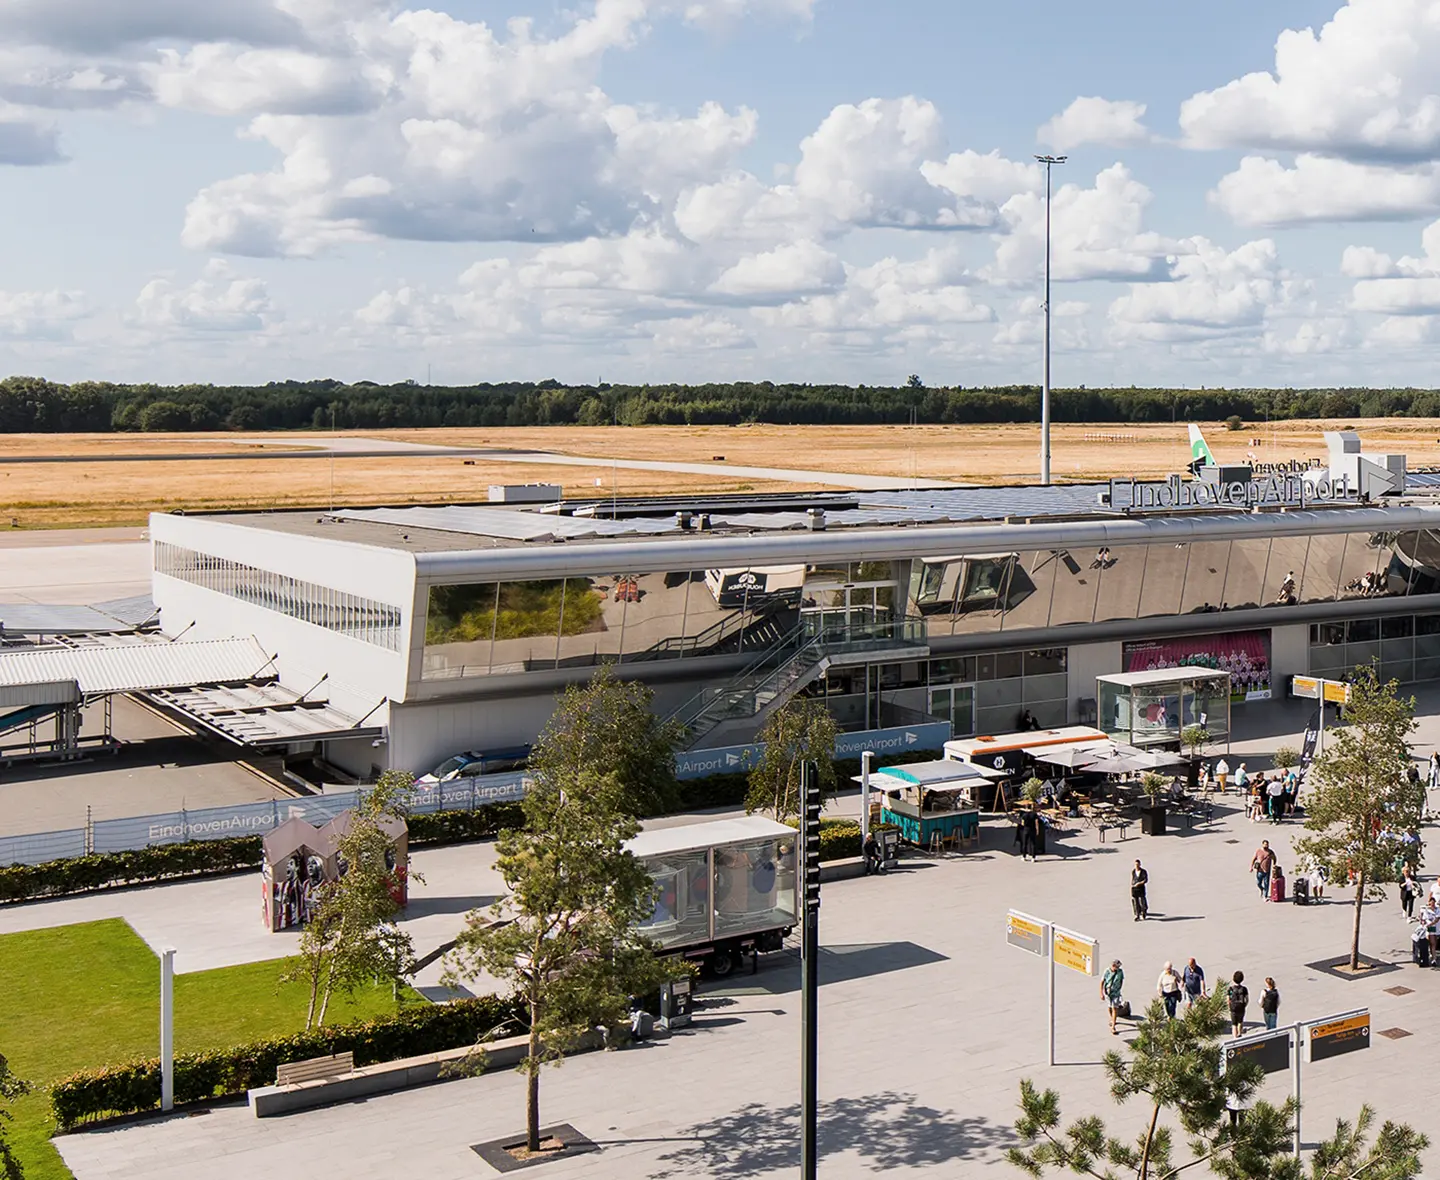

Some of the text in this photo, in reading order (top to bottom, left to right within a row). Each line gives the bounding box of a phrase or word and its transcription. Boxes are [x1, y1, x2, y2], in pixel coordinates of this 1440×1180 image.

[1109, 473, 1352, 510] EindhovenAirport
[835, 737, 902, 753] hovenAirport
[675, 758, 722, 773] nAirport
[401, 783, 517, 806] EindhovenAirport
[148, 811, 283, 838] EindhovenAirport
